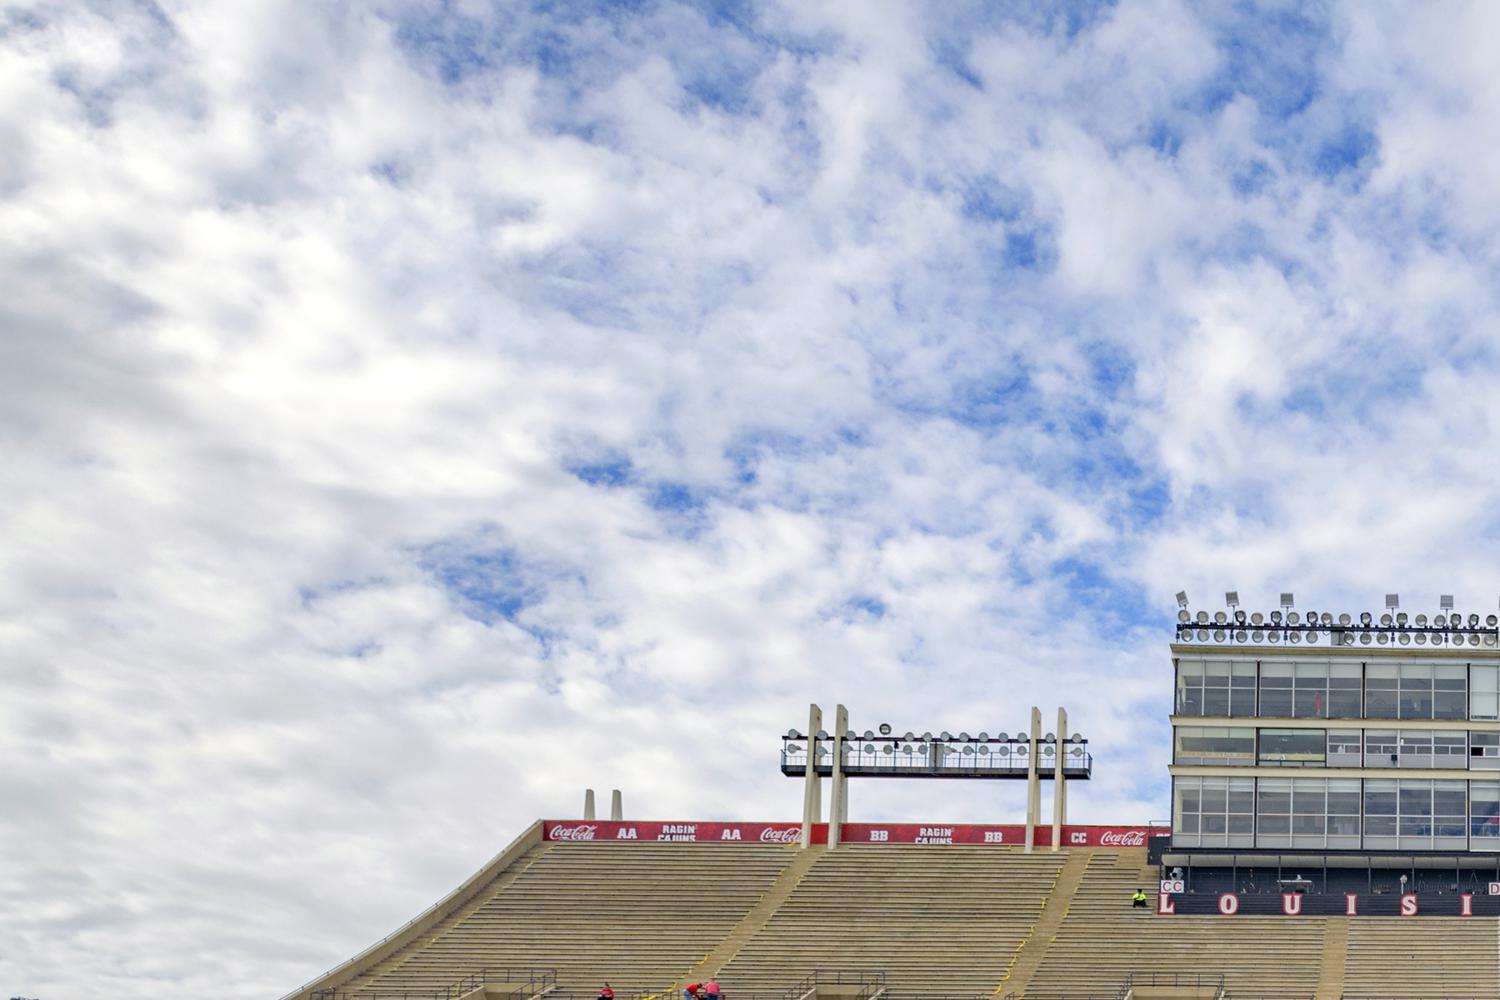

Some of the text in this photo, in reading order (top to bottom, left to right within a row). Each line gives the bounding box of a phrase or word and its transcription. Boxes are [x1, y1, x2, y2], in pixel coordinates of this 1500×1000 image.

[549, 824, 598, 841] Coca-Cola
[616, 828, 638, 840] AA
[721, 829, 742, 840] AA
[870, 830, 889, 842] BB
[984, 831, 1003, 843] BB
[1071, 832, 1087, 844] CC
[1100, 830, 1147, 846] Coca-Cola
[1162, 881, 1183, 892] CC
